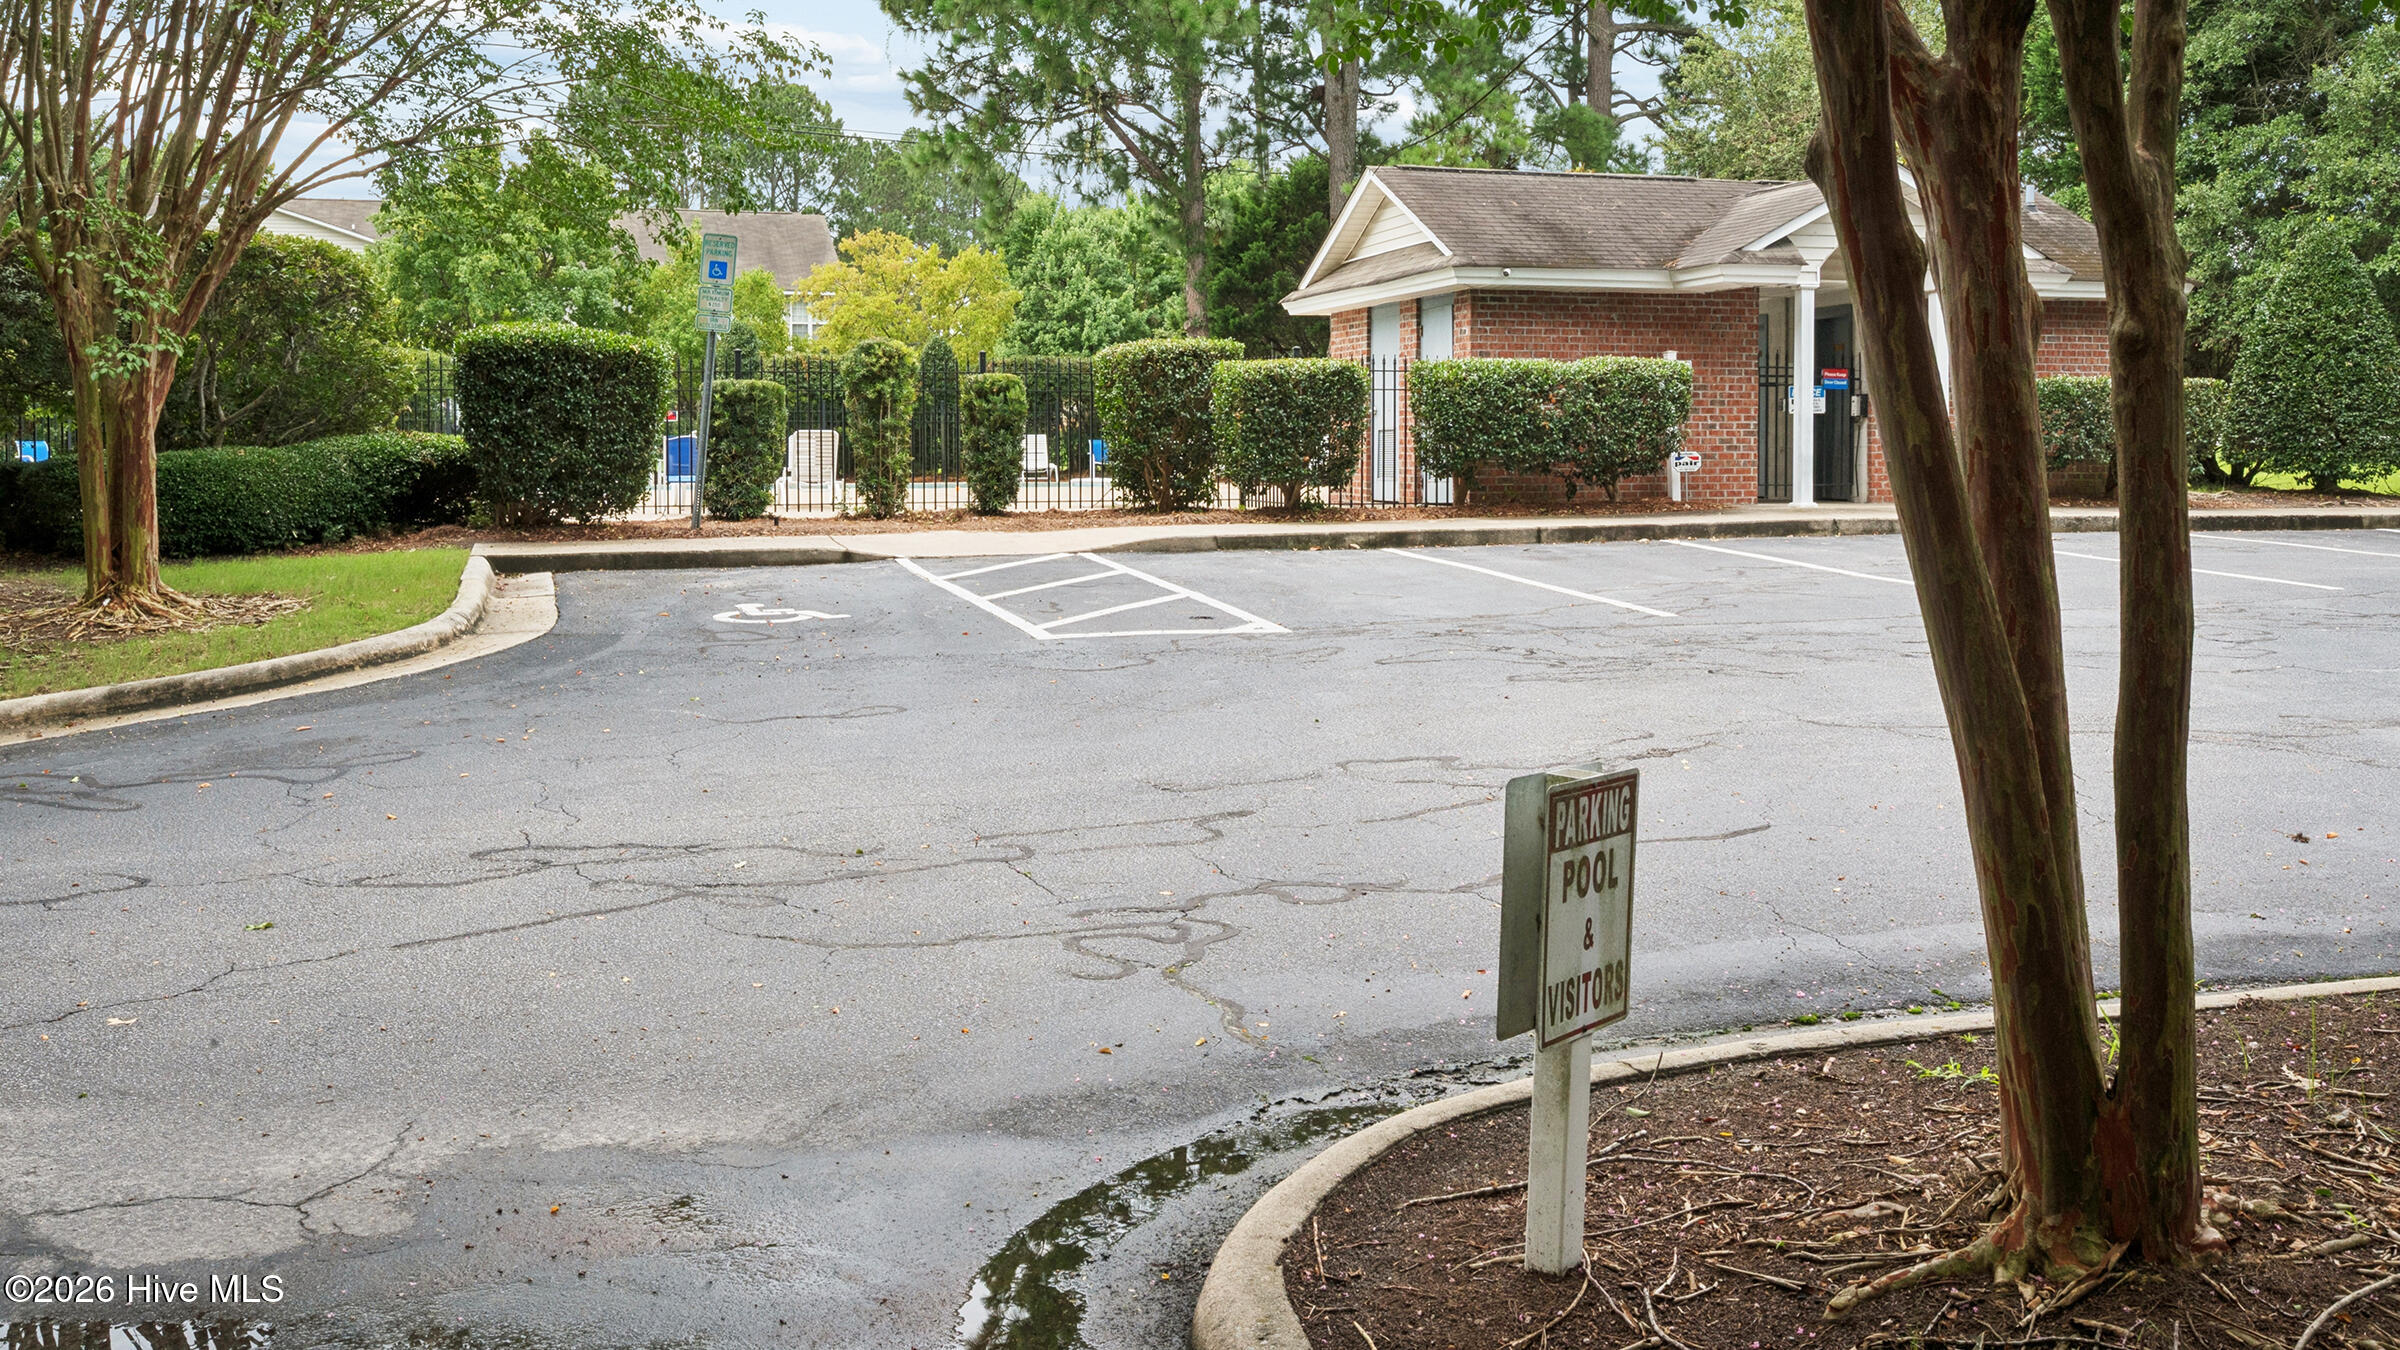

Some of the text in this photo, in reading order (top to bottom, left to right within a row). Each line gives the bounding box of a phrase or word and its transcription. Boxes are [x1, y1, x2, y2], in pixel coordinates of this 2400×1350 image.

[705, 247, 732, 257] PARKING
[1555, 785, 1631, 849] PARKING
[1563, 848, 1618, 904] POOL
[1583, 916, 1595, 951] &
[1548, 959, 1624, 1027] VISITORS
